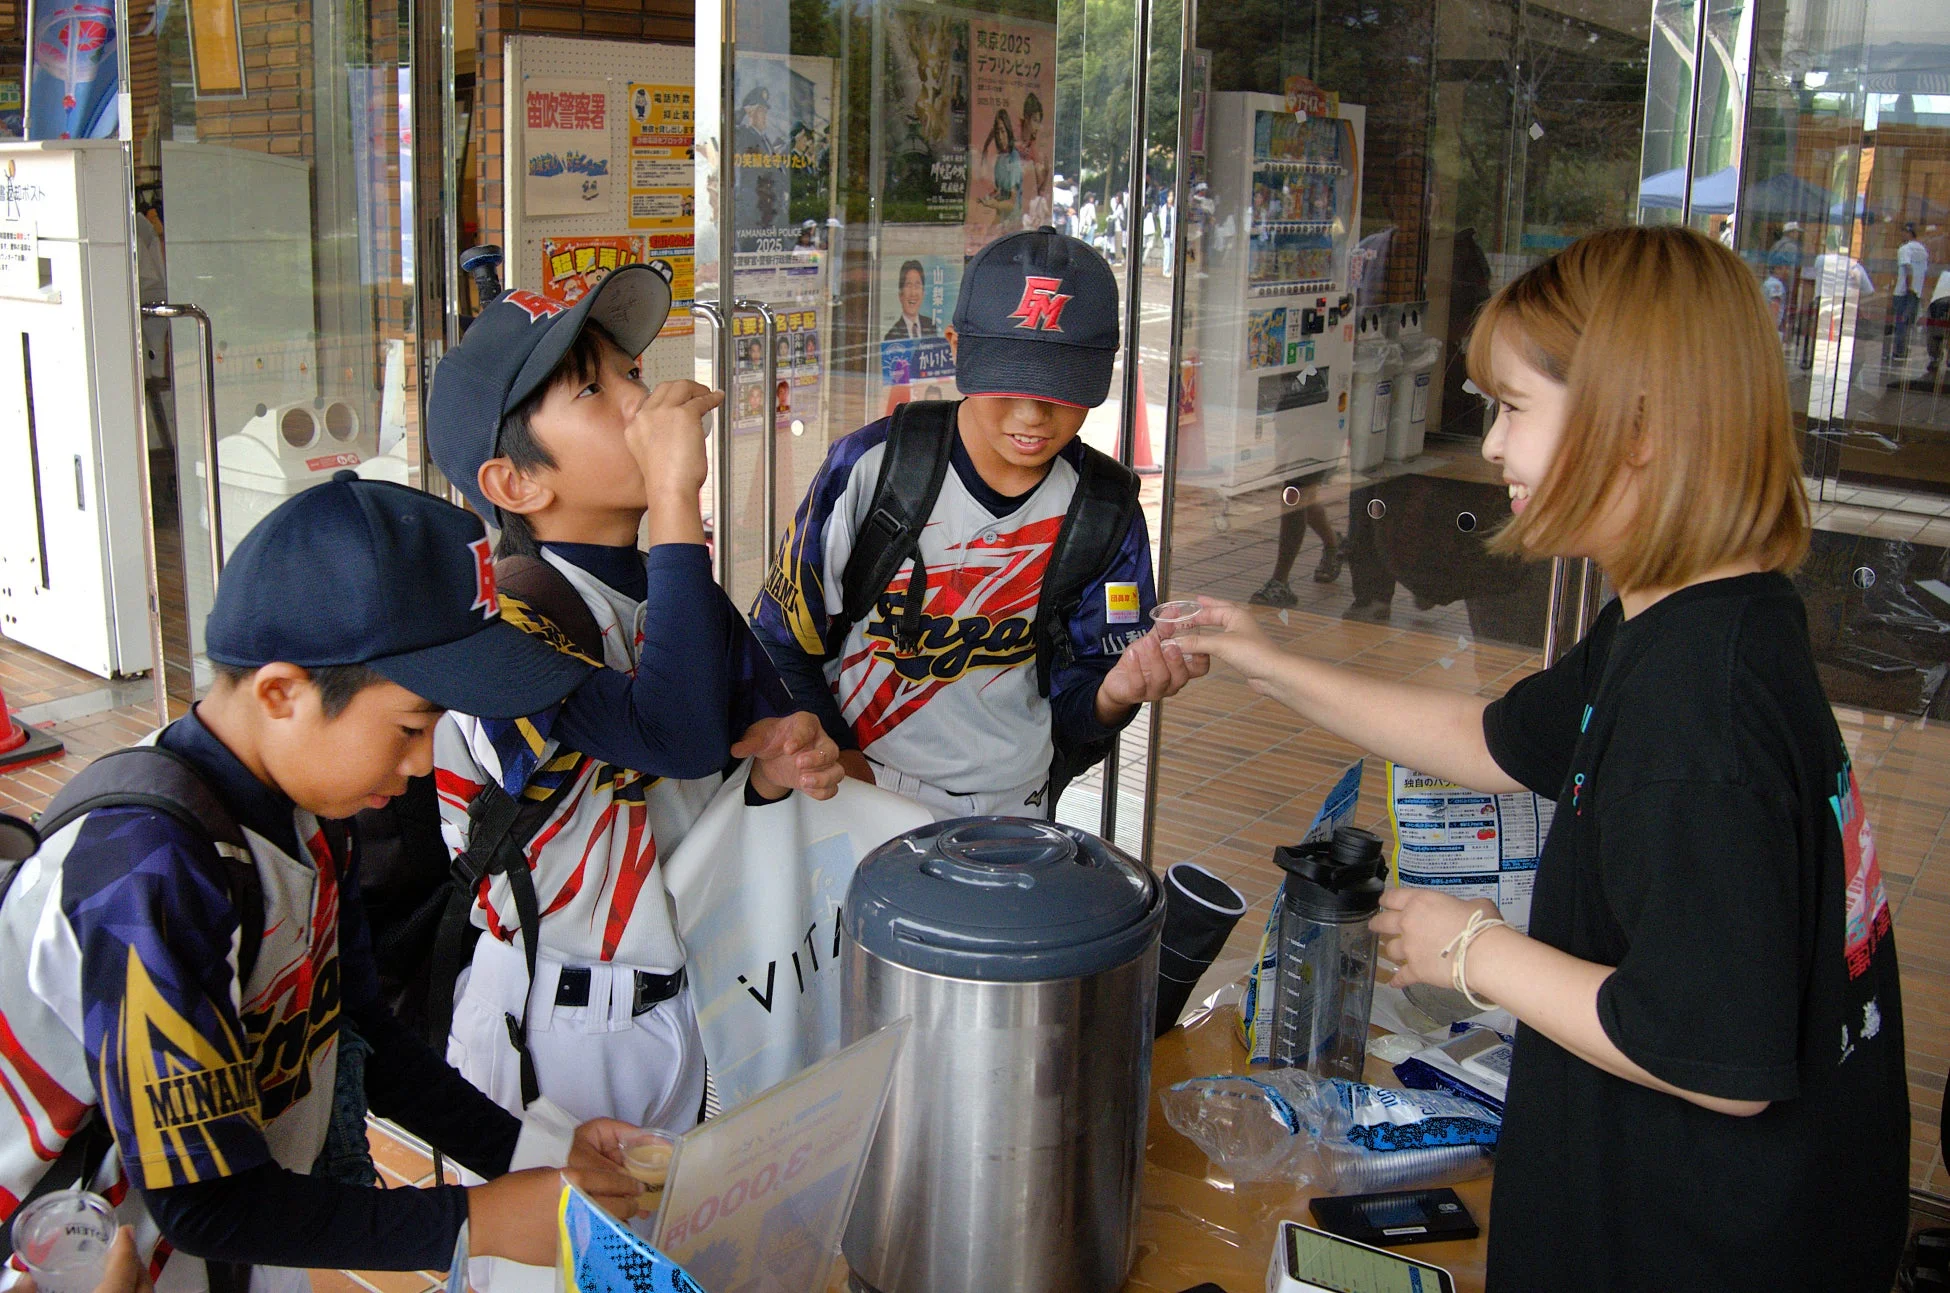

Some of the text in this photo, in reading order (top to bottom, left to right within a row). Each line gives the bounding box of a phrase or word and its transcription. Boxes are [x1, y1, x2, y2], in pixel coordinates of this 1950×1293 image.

[977, 30, 1031, 54] 東京2025
[977, 55, 1041, 78] デフリンピック
[527, 91, 605, 130] 笛吹警察署
[737, 227, 802, 238] YAMANASHI POLICE
[757, 238, 783, 252] 2025
